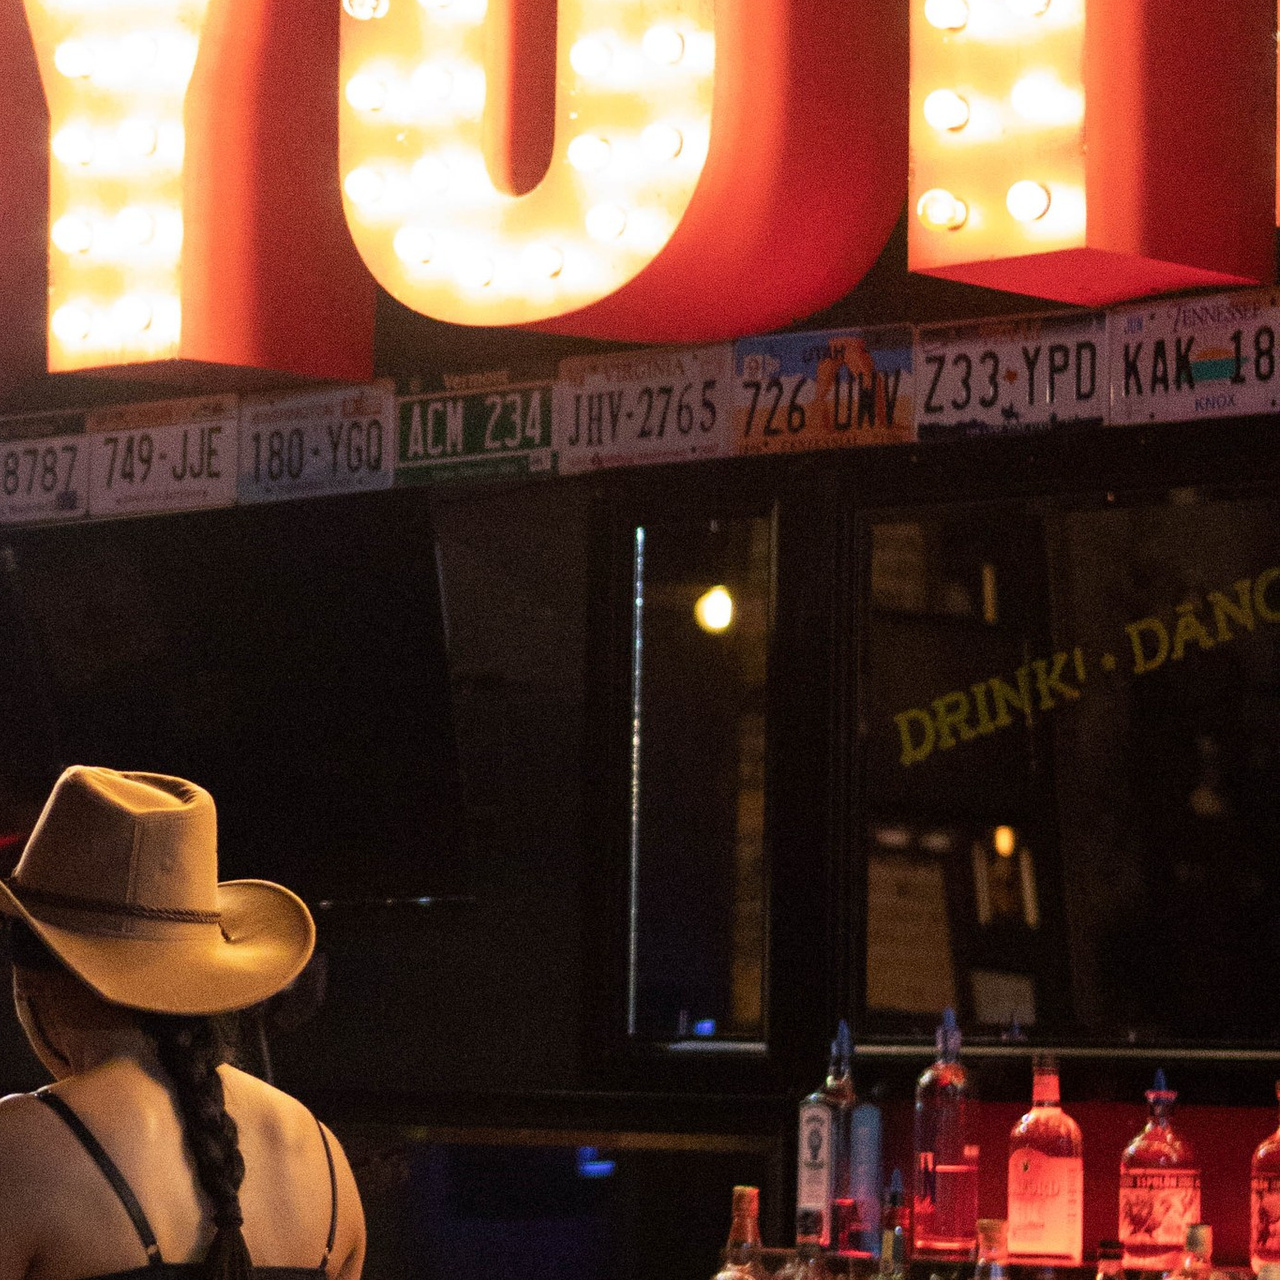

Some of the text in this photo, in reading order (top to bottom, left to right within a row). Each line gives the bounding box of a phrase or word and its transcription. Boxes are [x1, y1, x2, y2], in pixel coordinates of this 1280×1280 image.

[603, 359, 686, 384] VIRGINIA
[802, 345, 845, 364] UTAH
[923, 340, 1097, 414] Z33 YPD
[1123, 335, 1196, 396] KAK
[408, 398, 465, 458] ACM
[483, 389, 543, 449] 234
[742, 376, 808, 438] 726
[1194, 394, 1237, 411] KNOX
[2, 444, 79, 496] 8787
